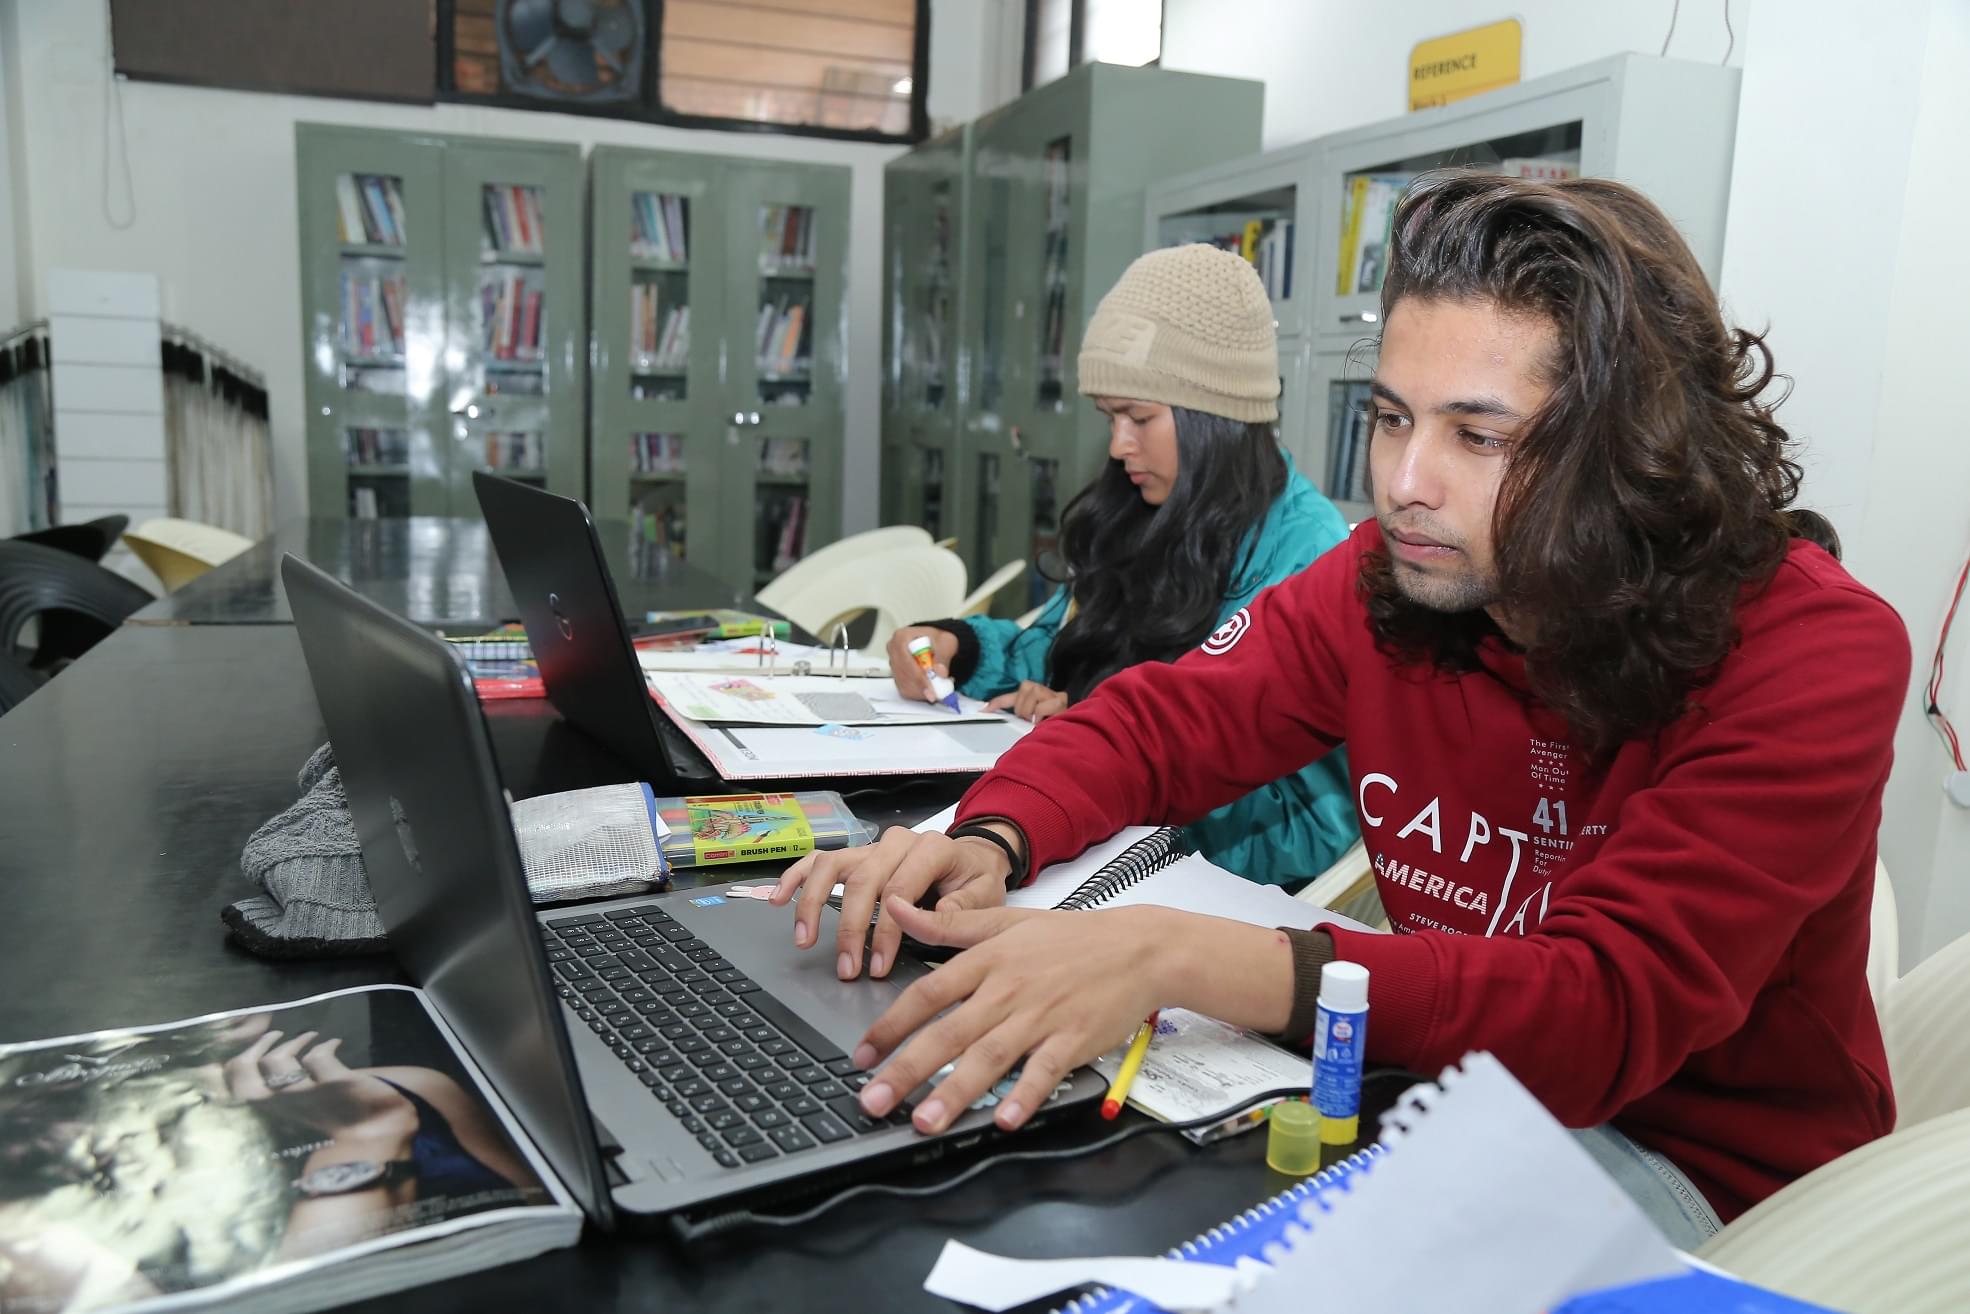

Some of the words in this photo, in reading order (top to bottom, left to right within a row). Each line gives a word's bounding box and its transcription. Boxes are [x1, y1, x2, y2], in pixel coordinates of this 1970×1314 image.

[1413, 53, 1476, 80] REFERENCE
[1530, 739, 1547, 748] The
[1530, 748, 1568, 759] Avenger
[1531, 764, 1549, 773] Man
[1544, 774, 1566, 784] Time
[1532, 797, 1568, 835] 41
[741, 848, 769, 856] BRUSH
[770, 846, 787, 854] PEN
[1535, 858, 1547, 867] For
[1374, 853, 1488, 915] AMERICA
[1409, 913, 1439, 929] STEVE
[1441, 925, 1468, 935] RO
